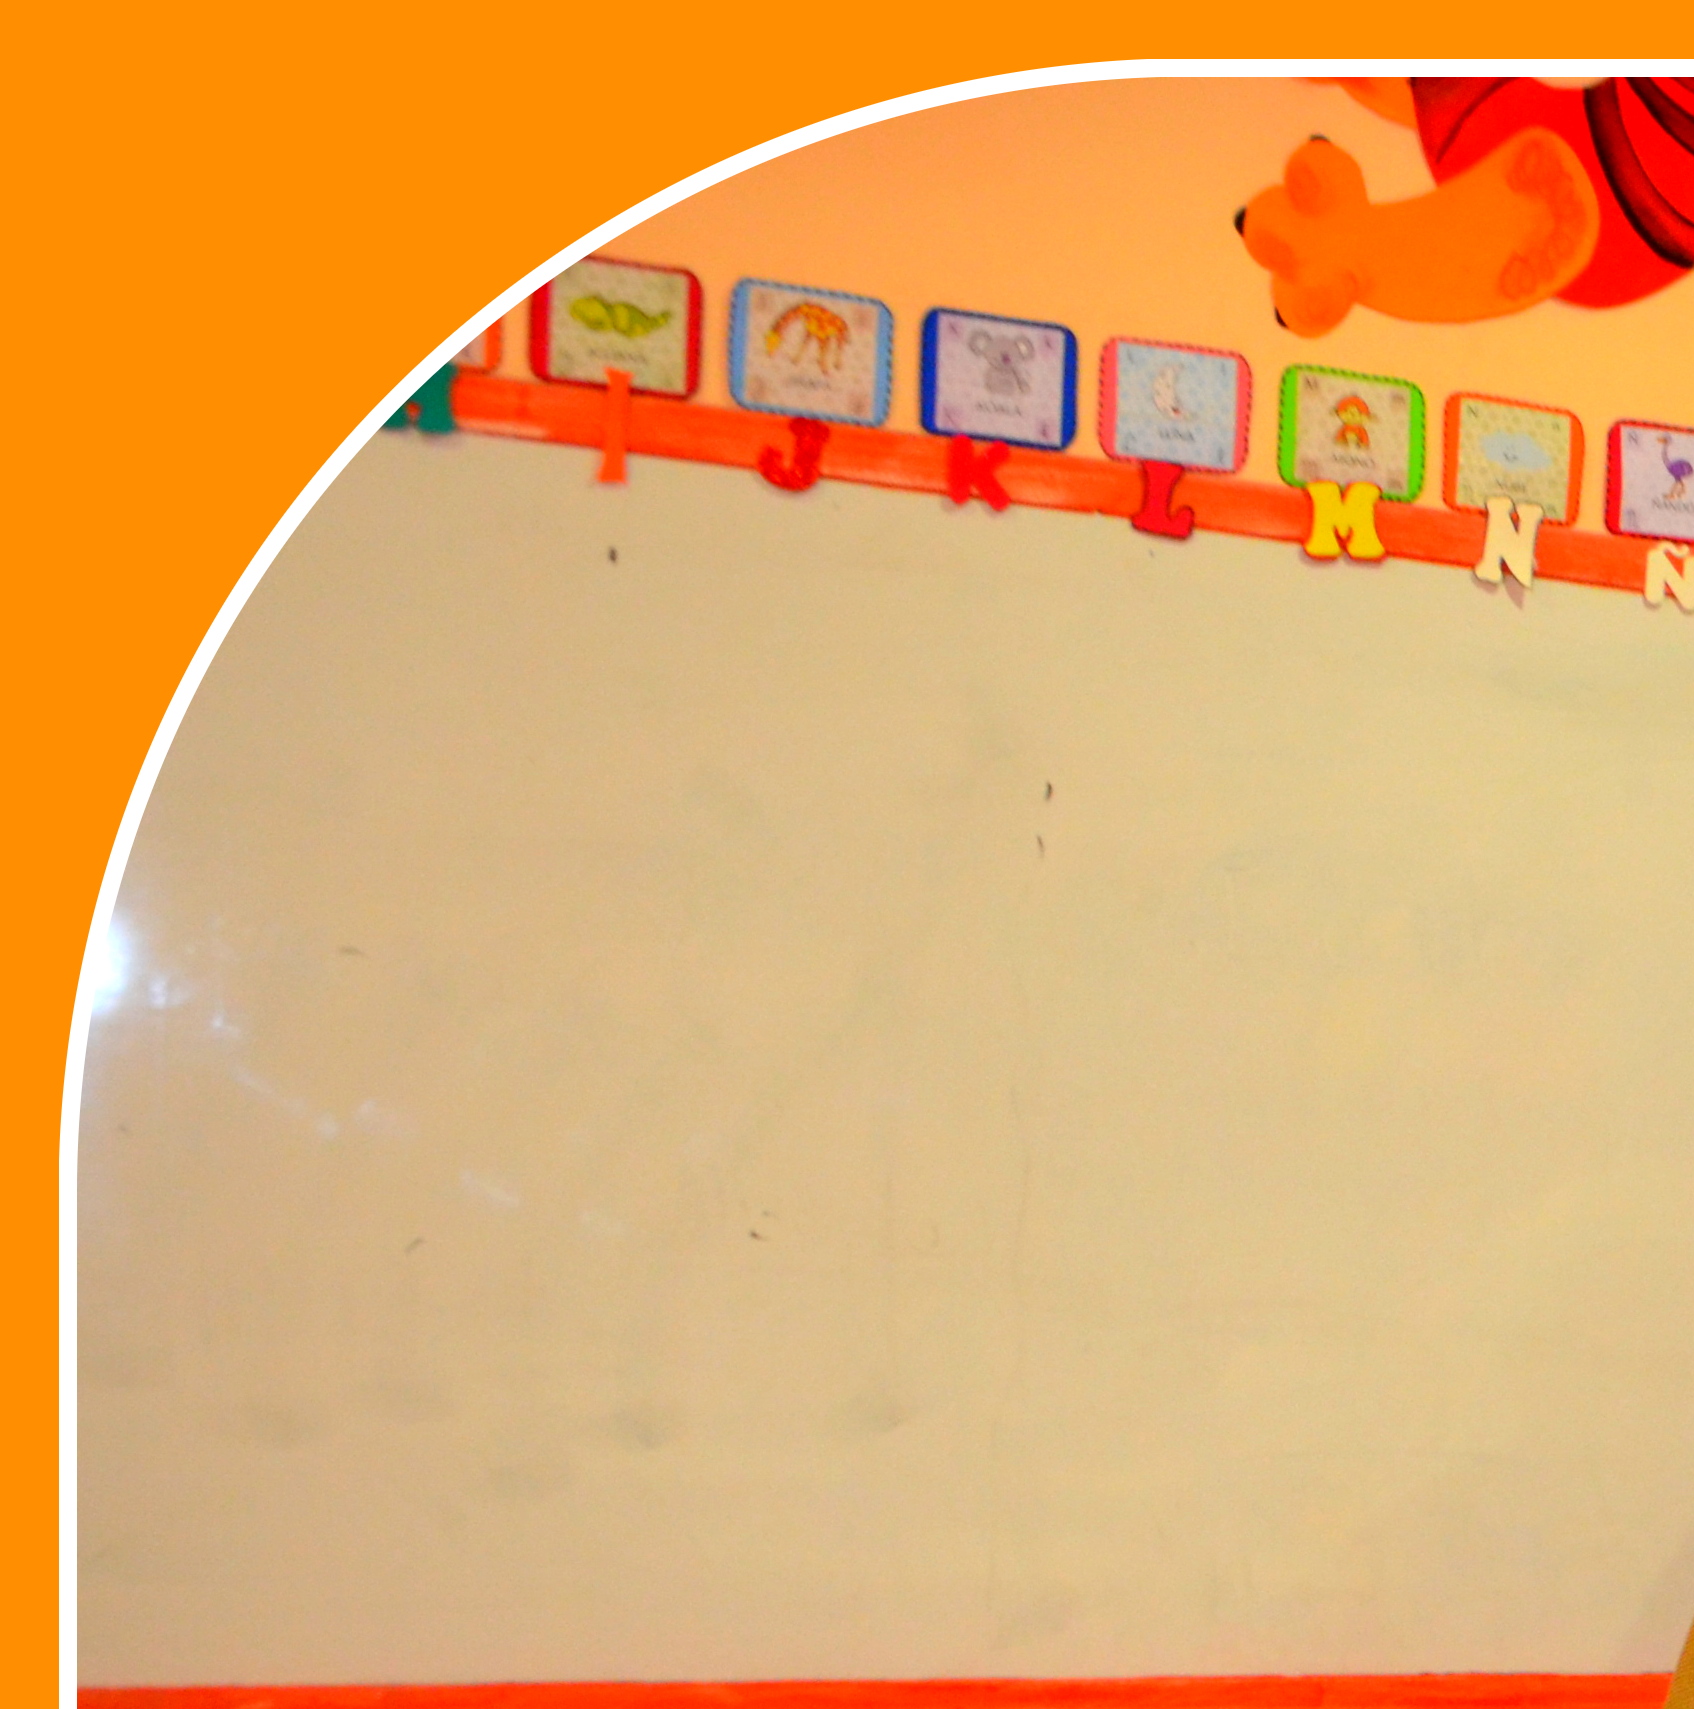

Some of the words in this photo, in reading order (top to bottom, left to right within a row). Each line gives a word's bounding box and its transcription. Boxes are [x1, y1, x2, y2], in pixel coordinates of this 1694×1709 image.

[760, 417, 830, 491] J
[946, 433, 1011, 512] K
[1131, 461, 1195, 540] L
[1303, 480, 1386, 560] M
[1474, 496, 1546, 588] N
